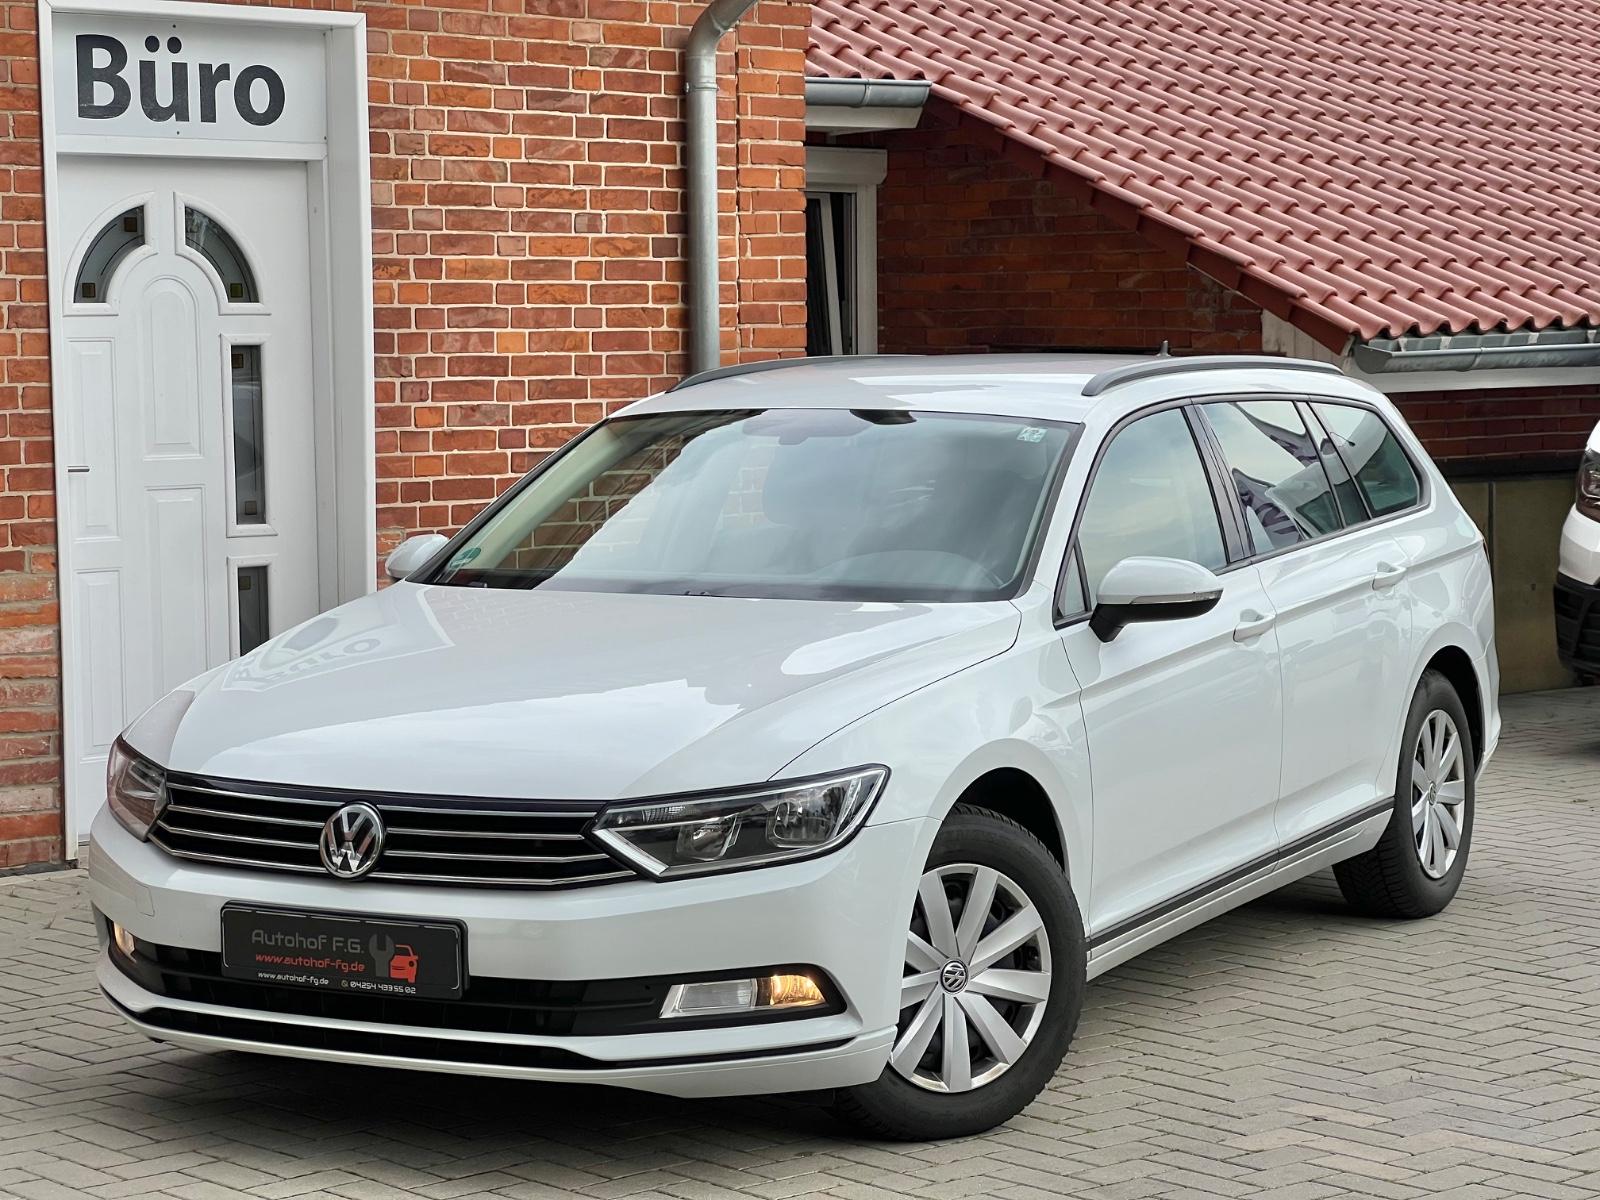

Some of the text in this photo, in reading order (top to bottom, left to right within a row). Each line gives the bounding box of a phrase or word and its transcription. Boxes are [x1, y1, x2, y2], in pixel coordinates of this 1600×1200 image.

[75, 33, 286, 127] Büro
[251, 929, 365, 954] Autohof F.G.
[255, 953, 366, 973] www.autohof-fg.de
[258, 972, 330, 986] www.autohof-fg.de
[350, 980, 377, 990] 04254
